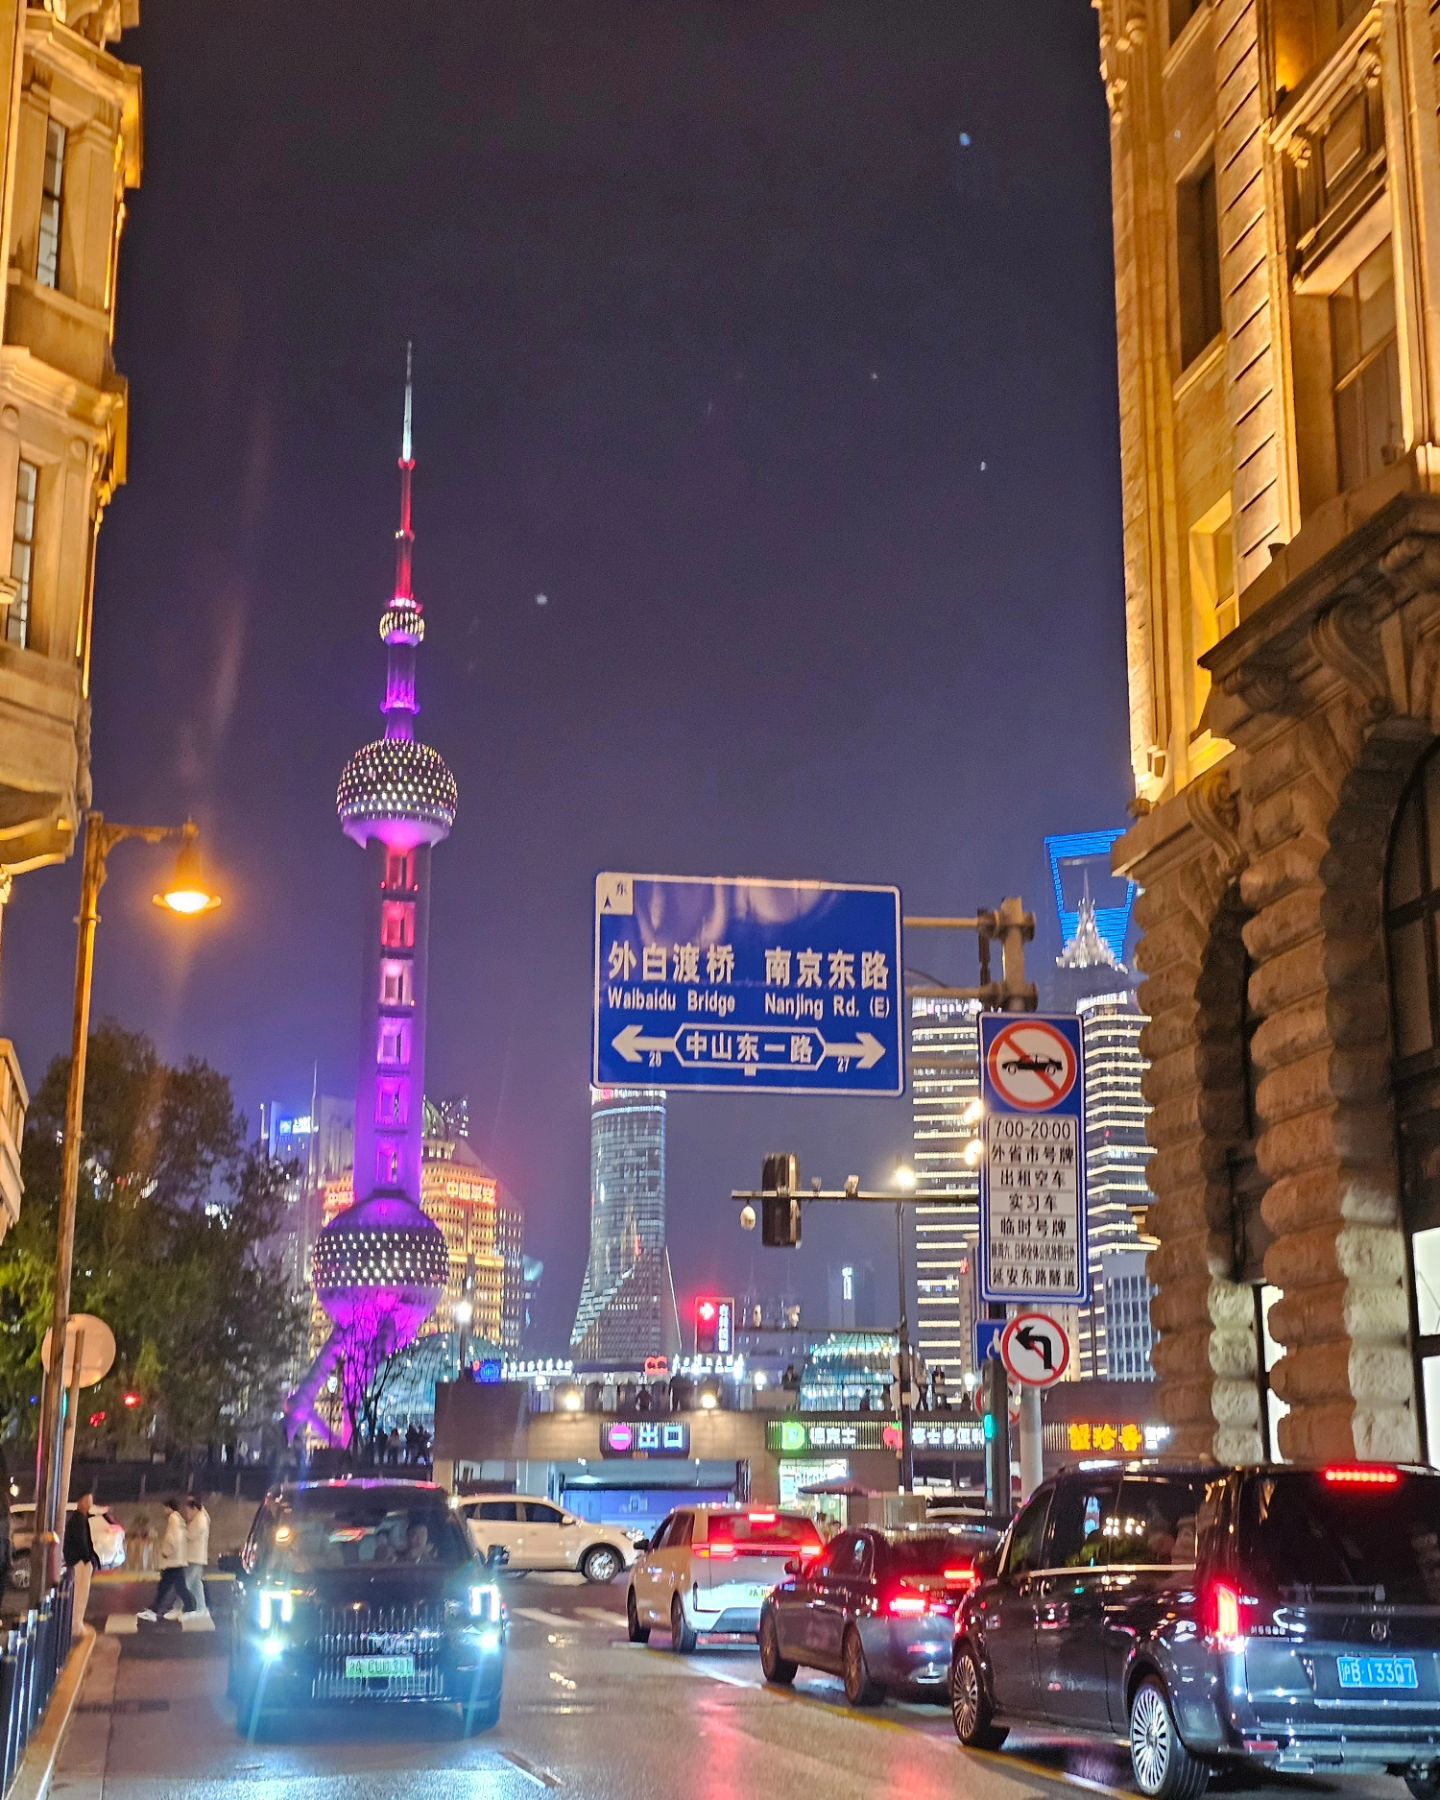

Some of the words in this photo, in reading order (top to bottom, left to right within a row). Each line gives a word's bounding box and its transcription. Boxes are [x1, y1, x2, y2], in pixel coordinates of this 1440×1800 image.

[608, 941, 735, 984] 外白渡桥
[764, 946, 889, 990] 南京东路
[608, 986, 676, 1011] Waibaidu
[687, 990, 735, 1016] Bridge
[764, 993, 823, 1020] Nanjing
[833, 995, 860, 1017] Rd.
[685, 1031, 813, 1064] 中山东一路
[837, 1056, 849, 1072] 27
[993, 1120, 1071, 1140] 7:00-20:00
[1001, 1216, 1066, 1238] 临时号牌
[993, 1266, 1075, 1287] 延安东路隧道
[639, 1424, 683, 1449] 出口
